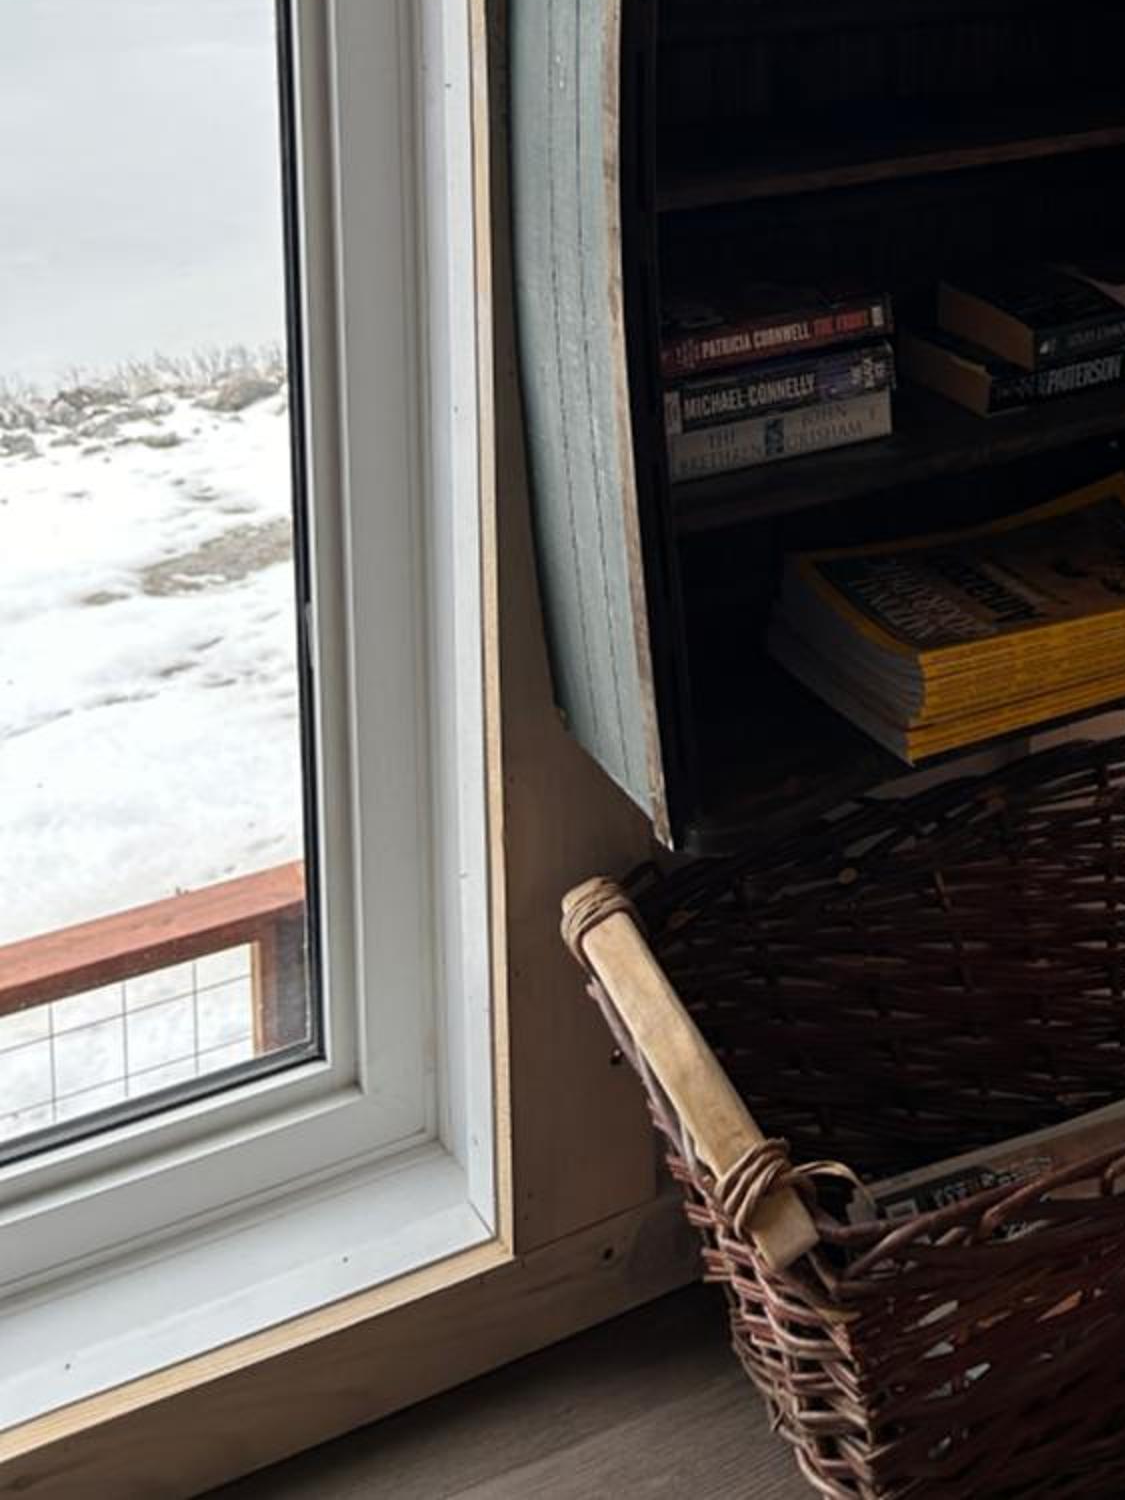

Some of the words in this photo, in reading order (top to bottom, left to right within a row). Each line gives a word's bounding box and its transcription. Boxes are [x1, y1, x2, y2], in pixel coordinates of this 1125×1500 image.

[702, 333, 751, 359] PATRICIA
[753, 320, 811, 350] CORNWELL
[683, 389, 745, 421] MICHAEL
[749, 371, 817, 407] CONNELLY
